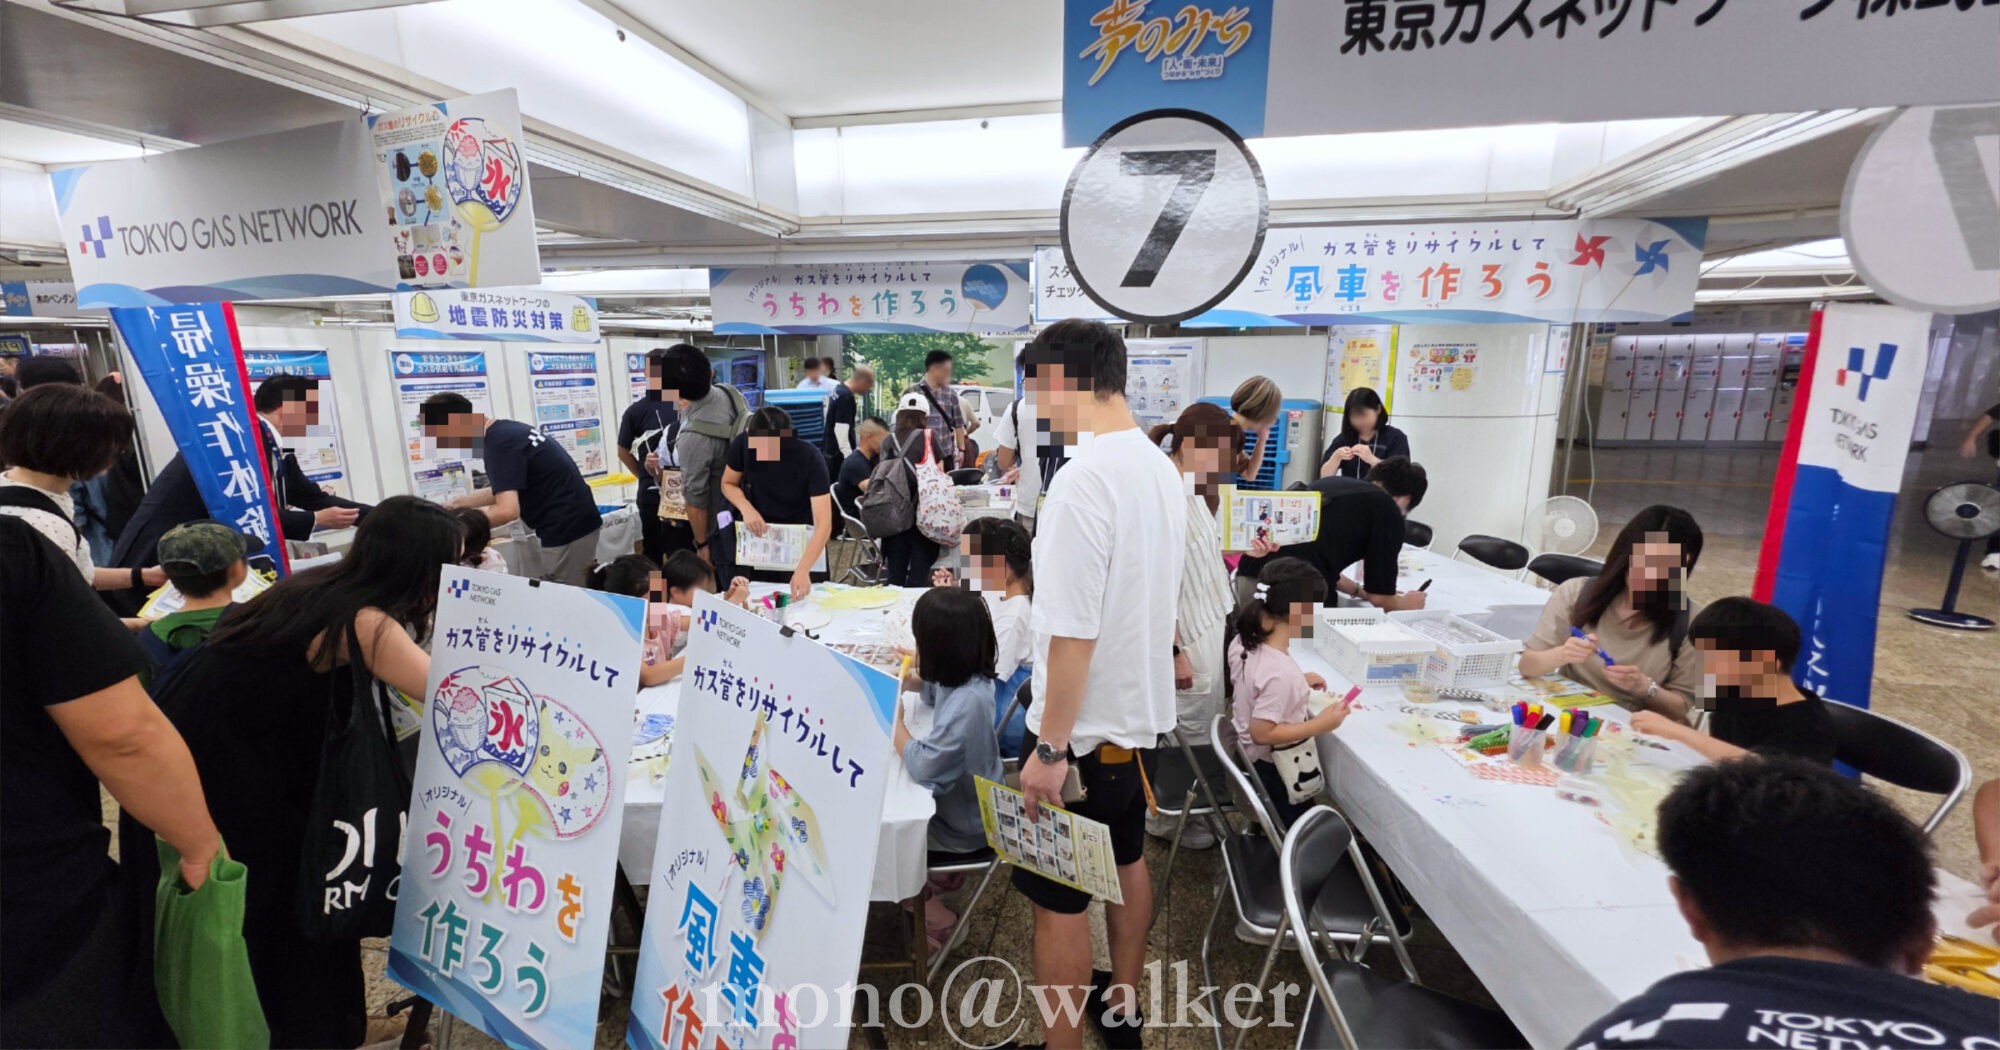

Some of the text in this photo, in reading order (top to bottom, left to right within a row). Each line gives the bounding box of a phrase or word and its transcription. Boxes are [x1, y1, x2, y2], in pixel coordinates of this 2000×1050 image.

[117, 199, 364, 256] TOKYO GAS NETWORK
[1120, 149, 1216, 287] 7
[1323, 237, 1546, 257] ガス管をリサイクルして
[460, 291, 550, 308] 東京ガスネットワークの
[1285, 260, 1552, 302] 風車を作ろう
[448, 304, 564, 331] 地震防災対策
[762, 288, 956, 319] うちわを作ろう
[446, 625, 619, 688] ガス管をリサイクルして
[694, 665, 864, 788] ガス管をリサイクルして
[425, 785, 468, 808] オリジナル
[425, 810, 582, 939] うちわを
[668, 849, 704, 879] オリジナル
[420, 900, 546, 1014] 作ろう
[1755, 1009, 1945, 1046] TOKYO
